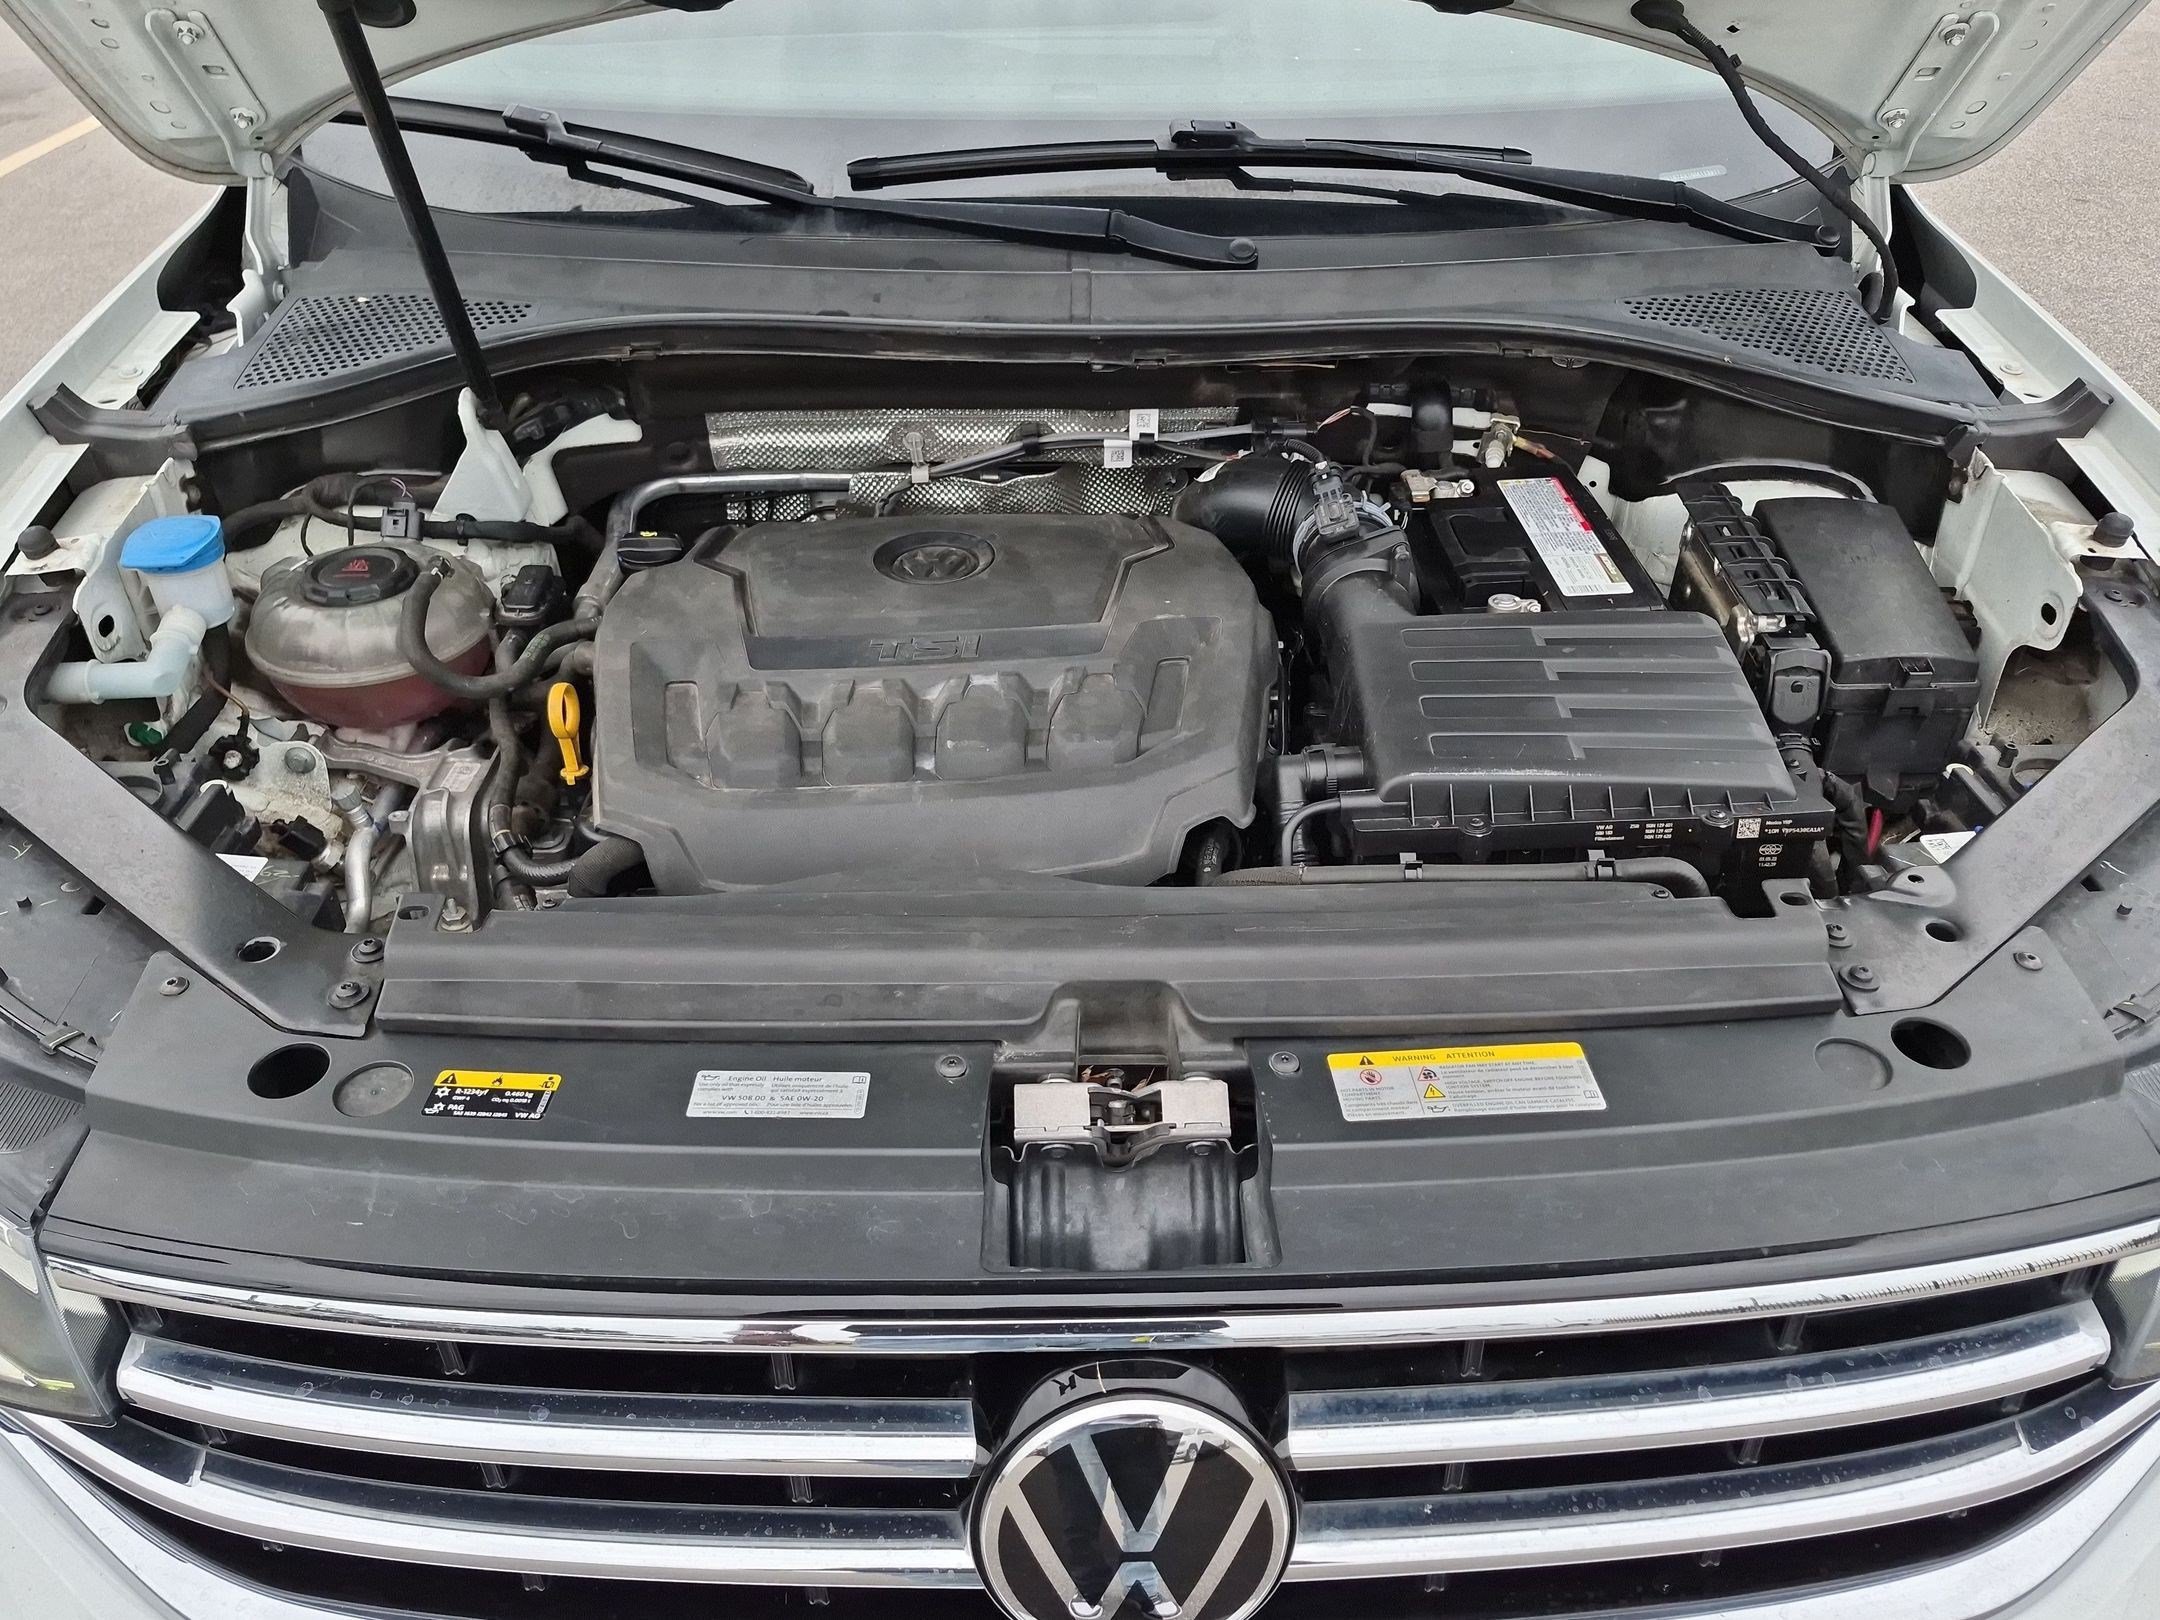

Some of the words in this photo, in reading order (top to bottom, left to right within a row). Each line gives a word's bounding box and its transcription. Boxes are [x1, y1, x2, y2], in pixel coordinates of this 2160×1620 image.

[869, 633, 982, 662] TSI
[1392, 1054, 1436, 1062] WARNING
[1446, 1051, 1496, 1059] ATTENTION
[728, 1075, 754, 1083] Engine
[455, 1088, 490, 1096] R-1234yf
